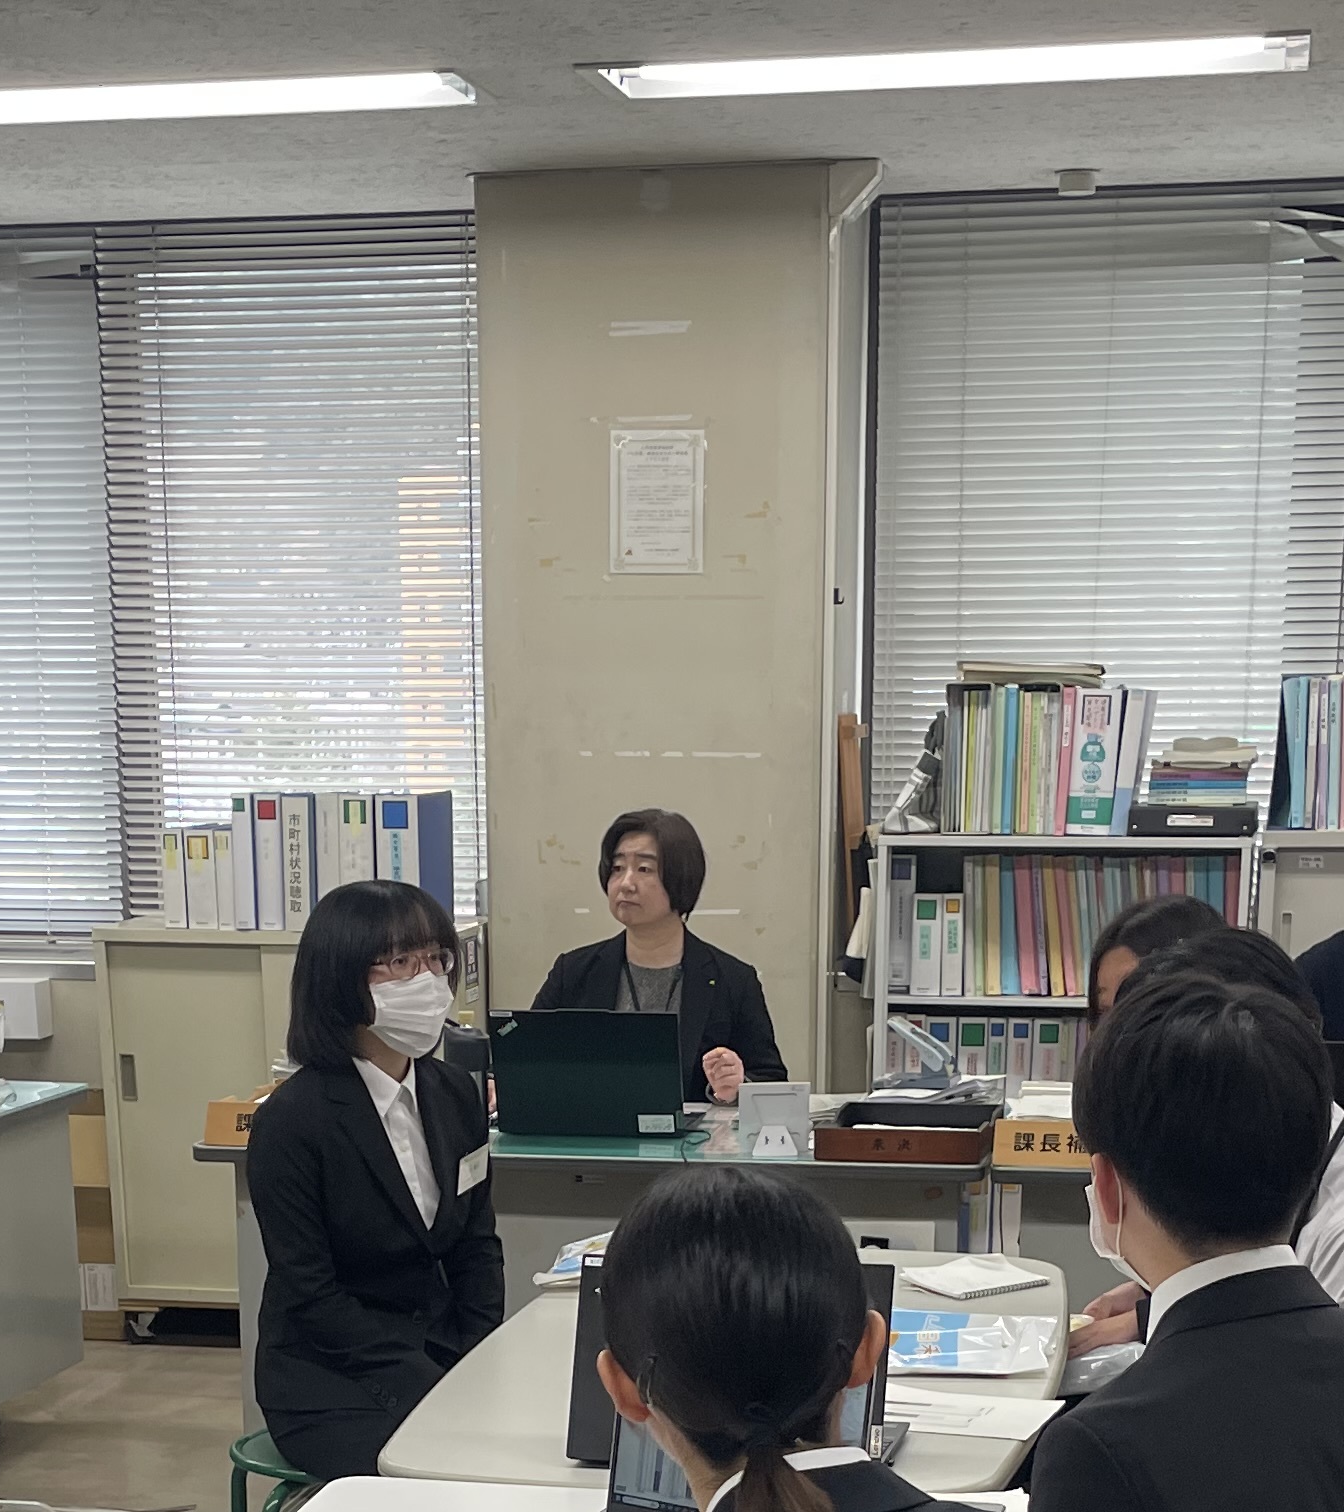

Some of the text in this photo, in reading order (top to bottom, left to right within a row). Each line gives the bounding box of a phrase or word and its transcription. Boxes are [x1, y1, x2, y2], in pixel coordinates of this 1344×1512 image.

[288, 814, 302, 913] 市町村状況聴取
[872, 1428, 881, 1456] Lenovo
